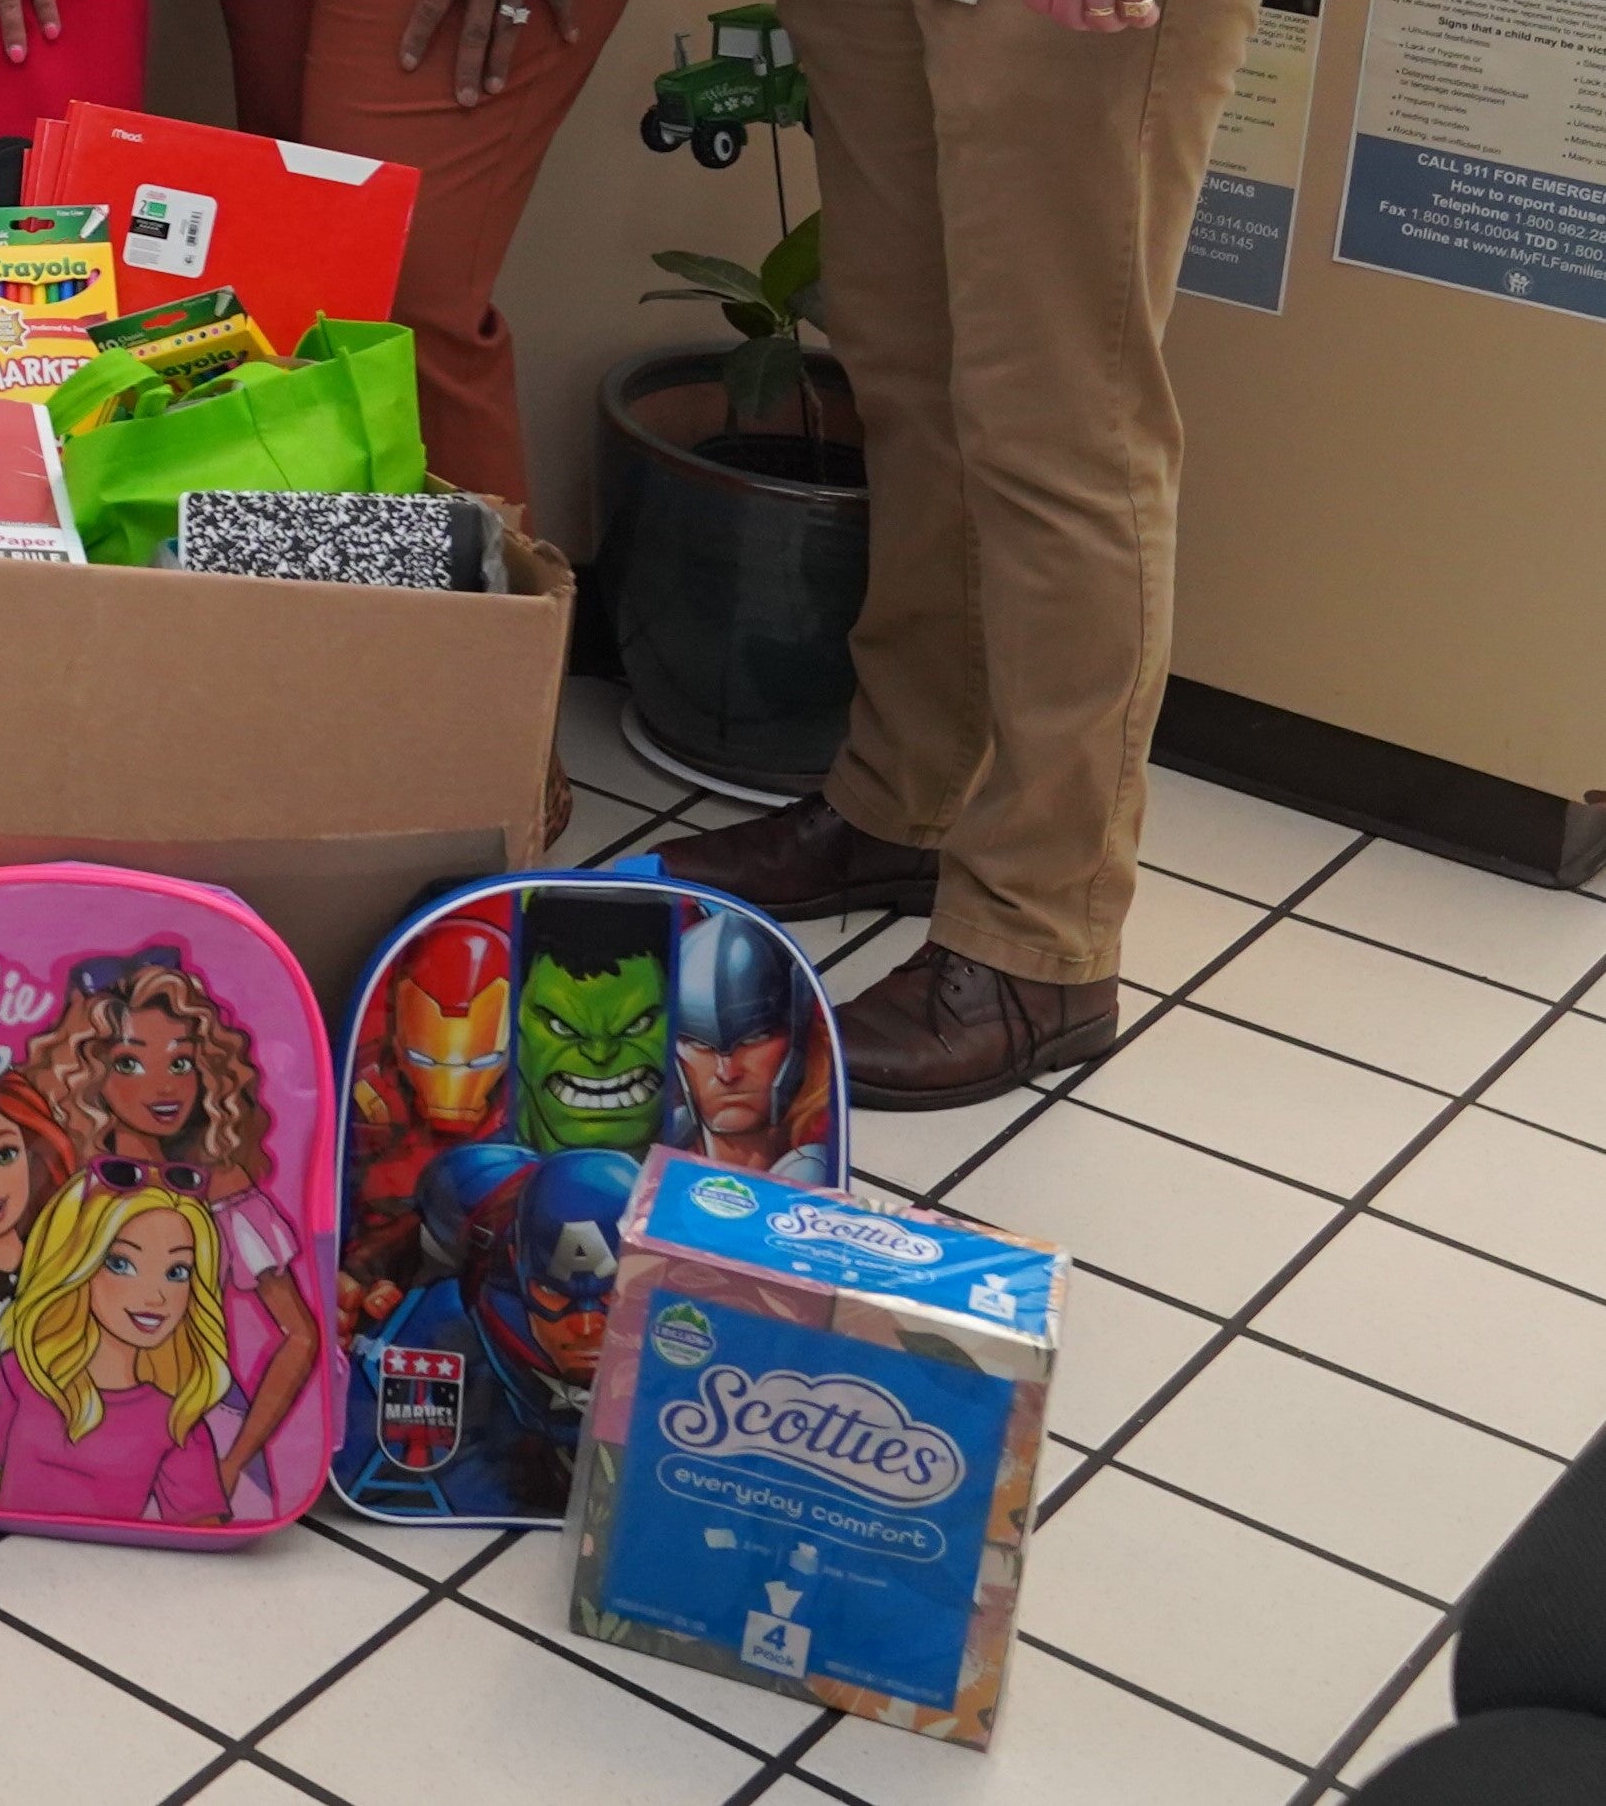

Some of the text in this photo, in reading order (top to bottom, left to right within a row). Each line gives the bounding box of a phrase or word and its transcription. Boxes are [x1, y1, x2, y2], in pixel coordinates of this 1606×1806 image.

[1438, 16, 1468, 30] Signs
[1472, 23, 1492, 34] that
[1505, 29, 1531, 41] child
[1534, 36, 1558, 49] may
[1560, 40, 1573, 50] be
[1418, 153, 1528, 187] CALL 911 FOR
[1432, 193, 1509, 222] Telephone
[1450, 179, 1556, 213] How to report
[1379, 200, 1557, 250] Fax 1.800.914.0004 TDD
[1401, 222, 1469, 249] Online at
[771, 1204, 928, 1258] Scotties
[665, 1366, 950, 1489] Scotties
[674, 1464, 929, 1551] everyday comfort
[763, 1624, 786, 1651] 4
